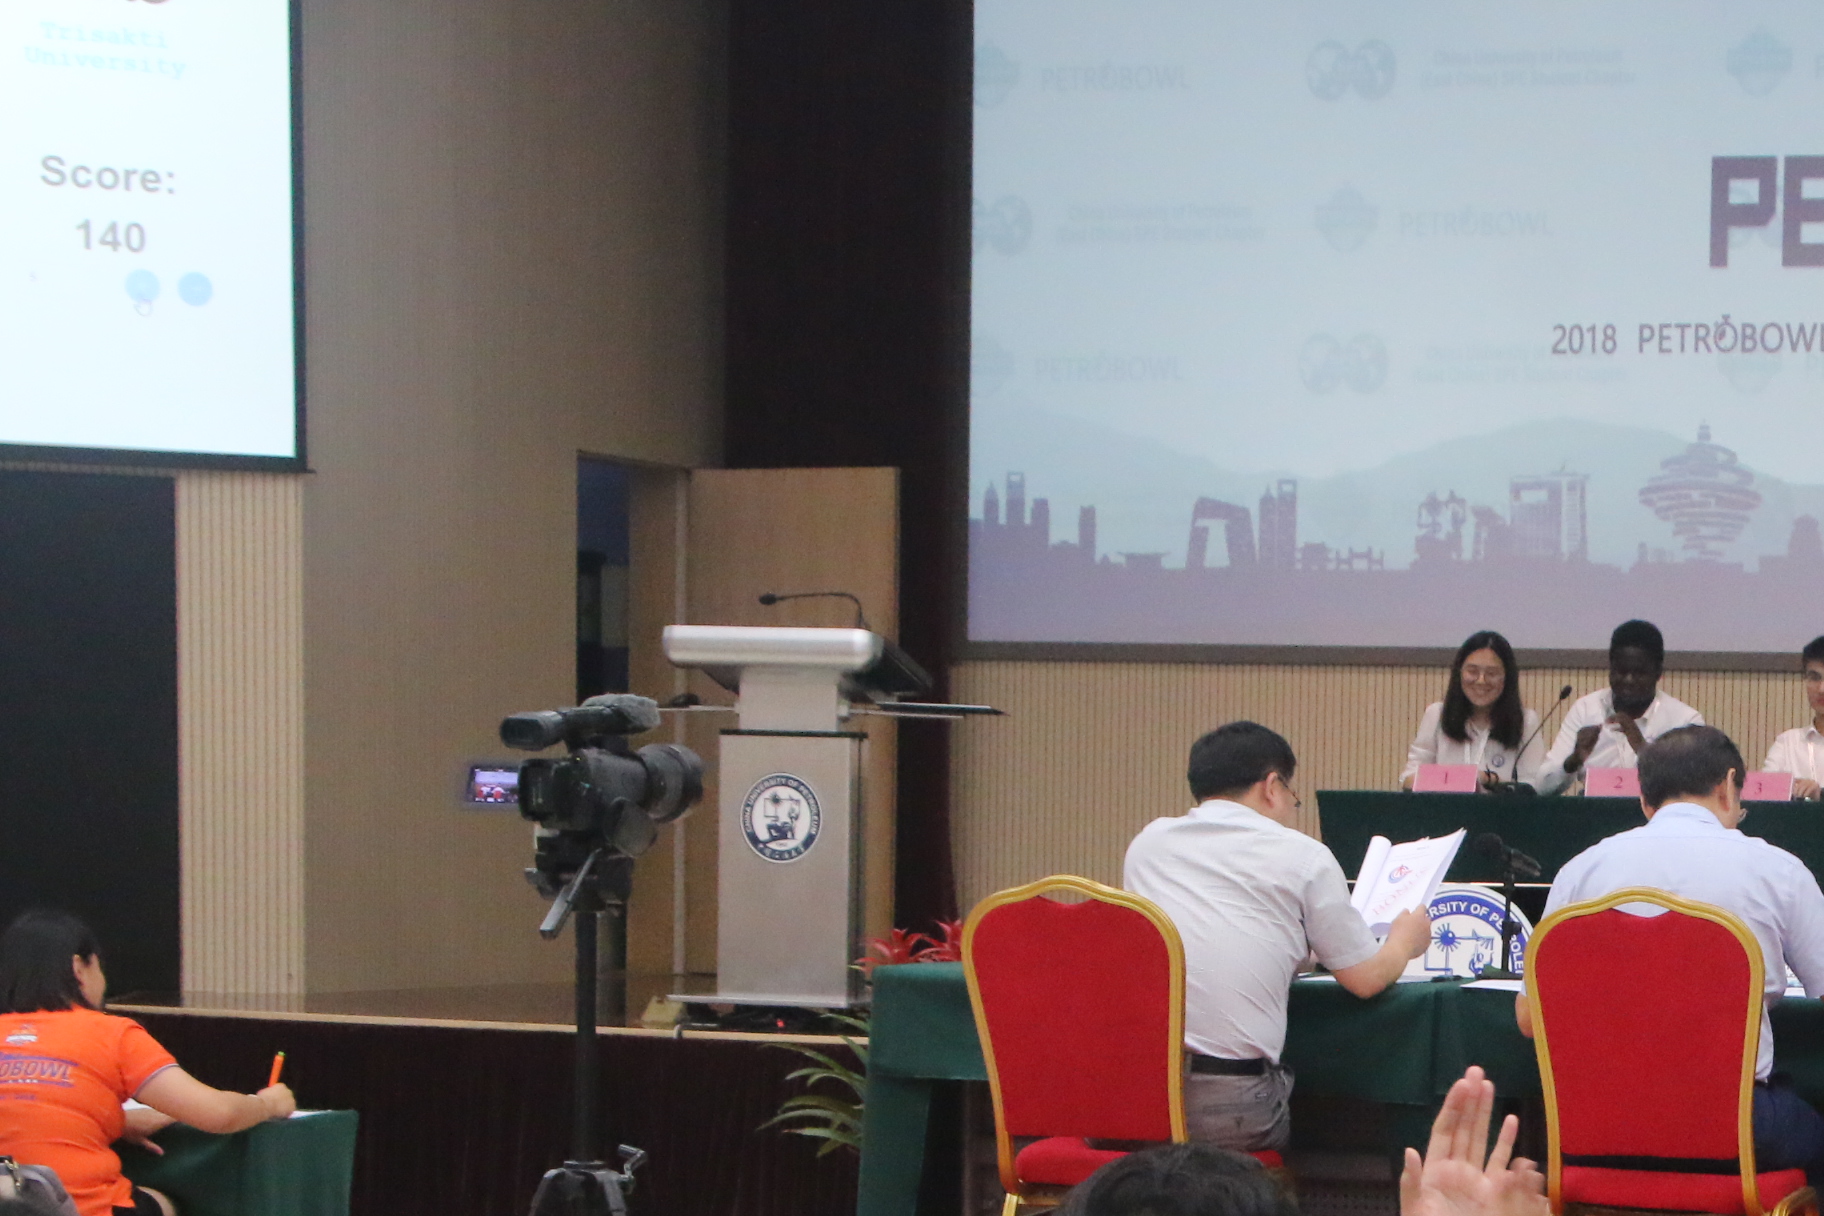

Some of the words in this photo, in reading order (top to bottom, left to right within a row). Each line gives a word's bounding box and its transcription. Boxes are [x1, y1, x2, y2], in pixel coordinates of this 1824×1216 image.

[40, 21, 168, 50] Trisakti
[22, 45, 188, 81] University
[40, 154, 176, 195] Score:
[76, 218, 147, 254] 140
[1552, 323, 1617, 354] 2018
[1443, 771, 1450, 785] 1
[1613, 775, 1624, 790] 2
[1754, 781, 1764, 795] 3
[1426, 901, 1468, 918] RSITY
[1470, 903, 1490, 917] OF
[0, 1061, 71, 1081] OBOWL
